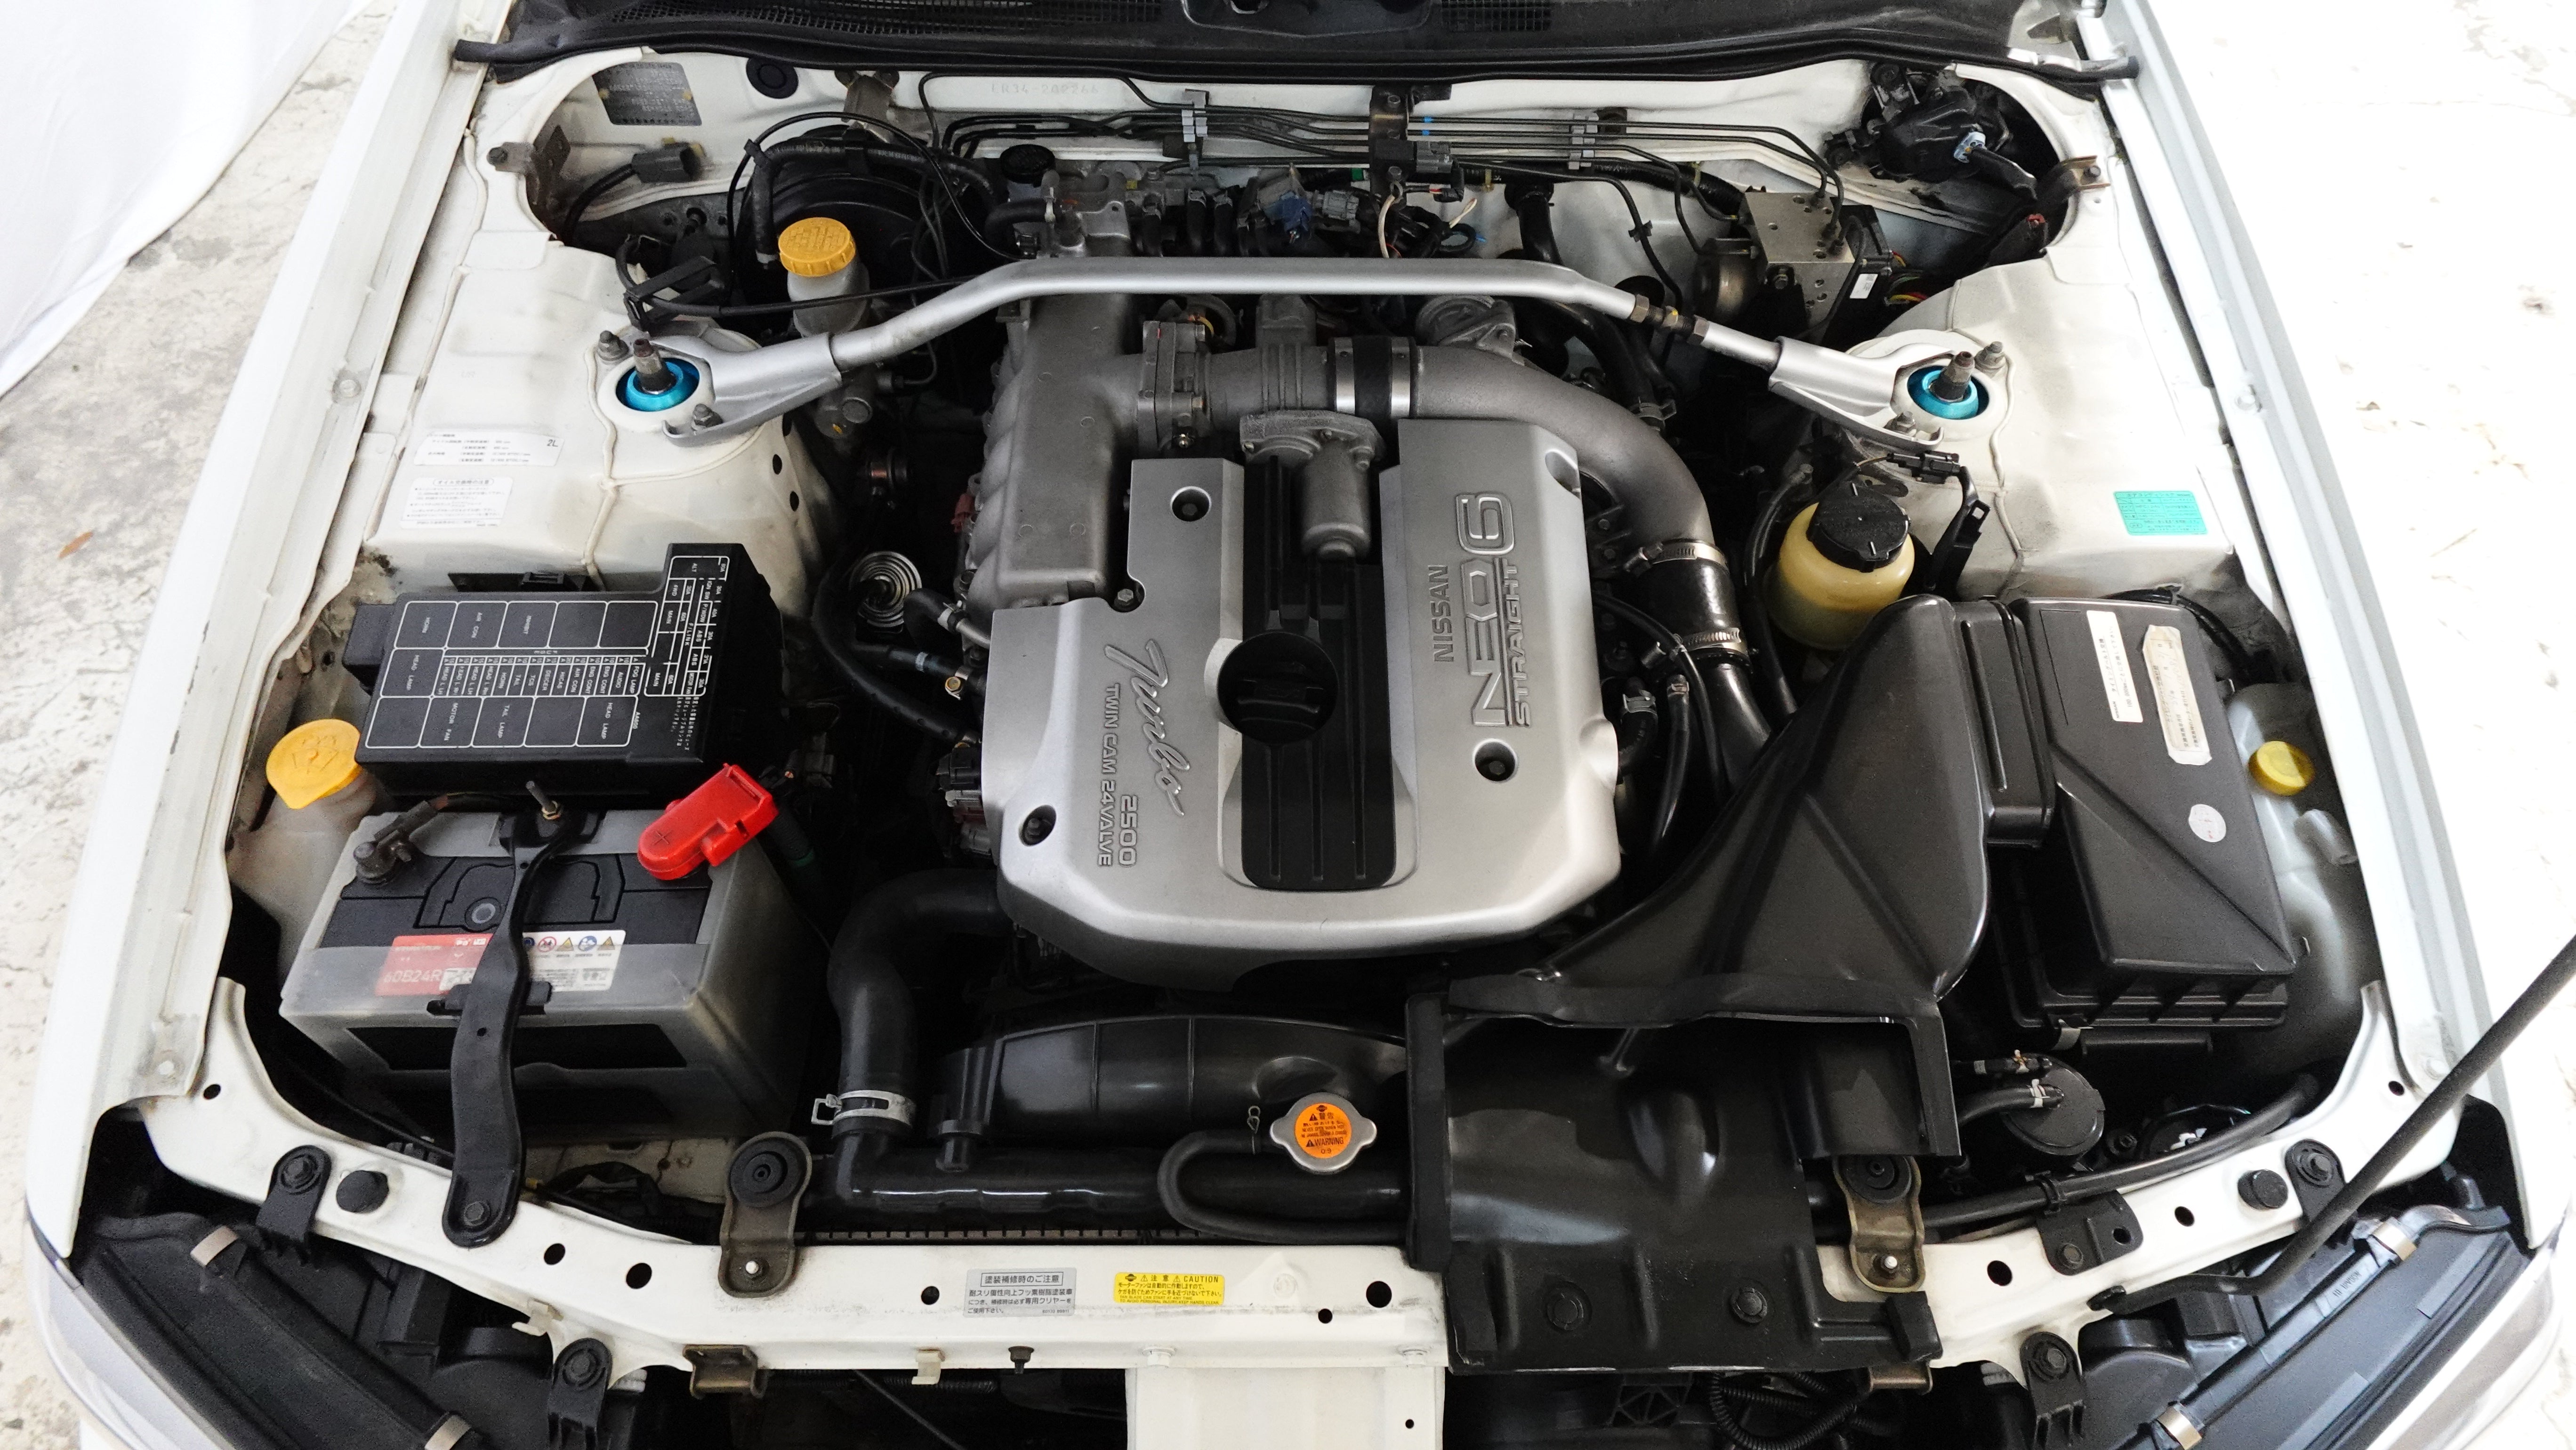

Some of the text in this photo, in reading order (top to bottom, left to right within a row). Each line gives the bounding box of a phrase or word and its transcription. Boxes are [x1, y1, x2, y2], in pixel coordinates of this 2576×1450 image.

[704, 591, 710, 599] SW
[700, 604, 708, 622] P/WDW
[1428, 565, 1454, 662] NISSAN
[422, 617, 430, 633] HORN
[1502, 565, 1530, 727] STRAIGHT
[406, 655, 419, 690] HEAD LAMP
[442, 667, 450, 680] HEAD
[456, 666, 464, 680] HEAD
[498, 672, 507, 688] HORN
[542, 670, 551, 691] DEICER
[557, 671, 565, 689] HICAS
[616, 672, 624, 688] AUDIO
[449, 702, 458, 724] MOTOR
[502, 705, 510, 717] TAIL
[605, 702, 613, 718] HEAD
[1103, 682, 1121, 729] TWIN
[2112, 701, 2120, 719] NISSAN
[1103, 638, 1190, 817] Turbo
[1101, 733, 1118, 775] CAM
[1119, 795, 1138, 868] 2500
[383, 968, 443, 983] 60B24R
[1315, 1136, 1344, 1146] WARNING
[984, 1275, 1059, 1284] 塗装補修時のご注意
